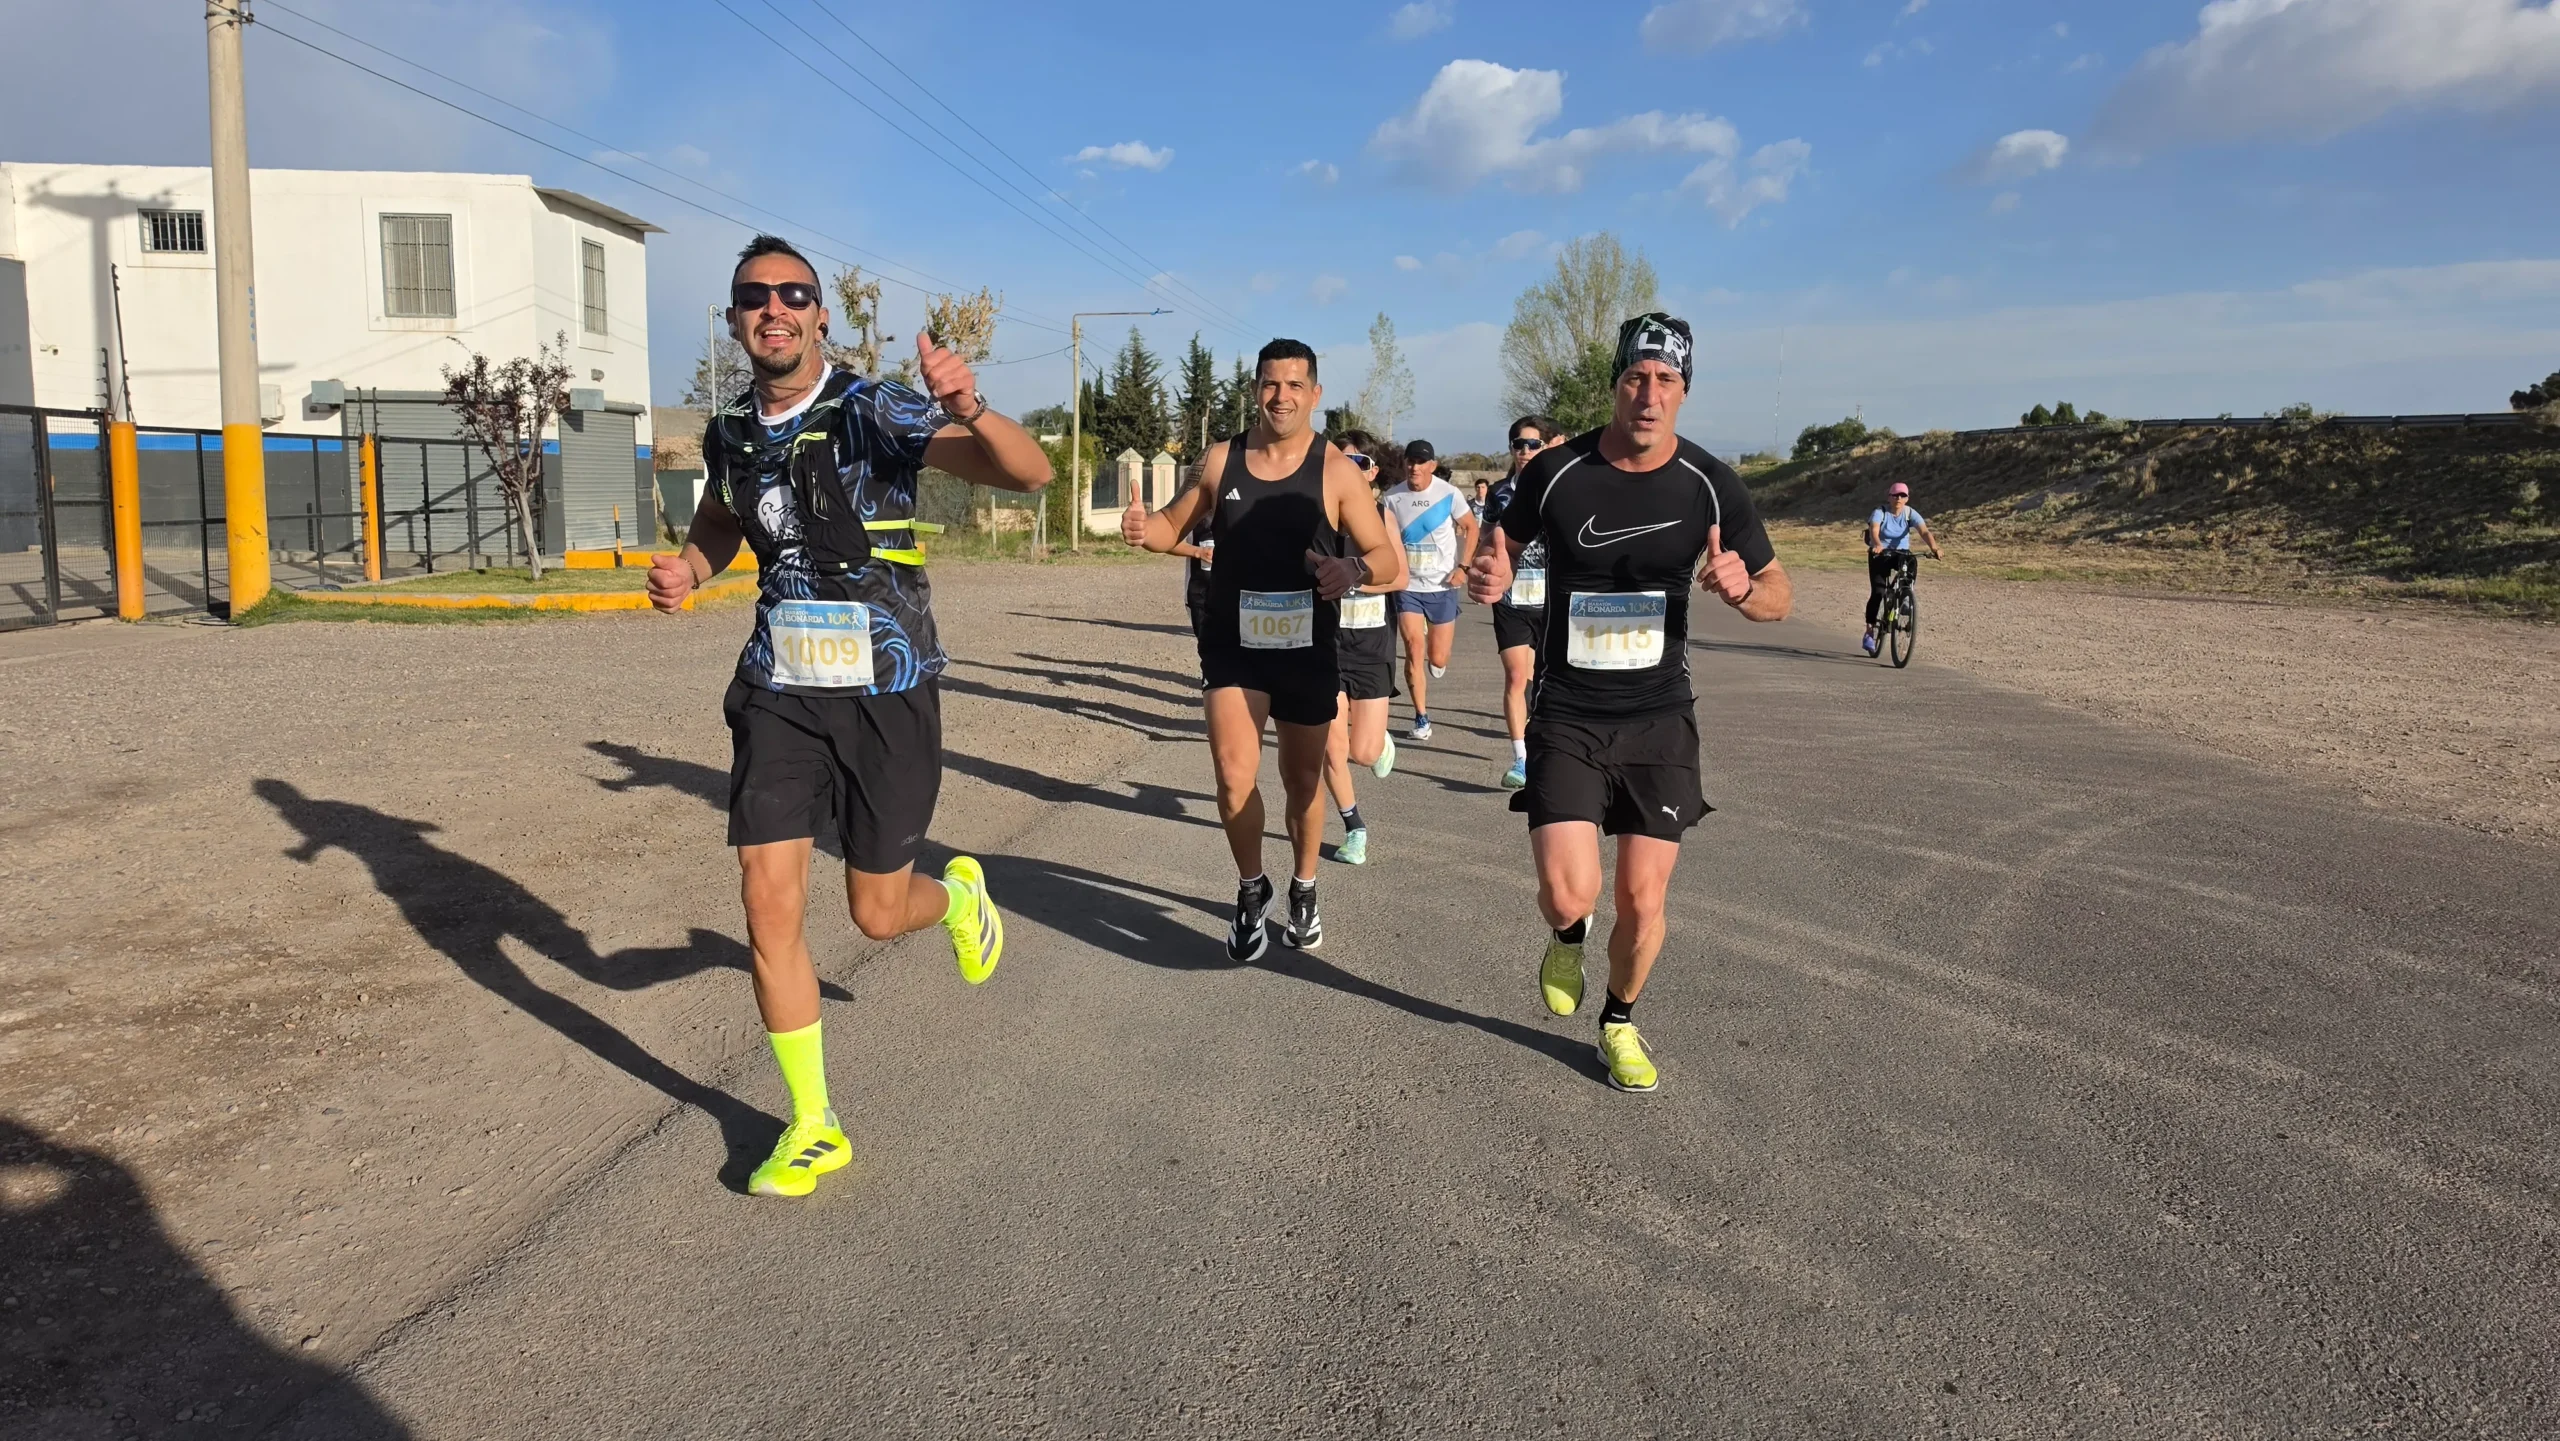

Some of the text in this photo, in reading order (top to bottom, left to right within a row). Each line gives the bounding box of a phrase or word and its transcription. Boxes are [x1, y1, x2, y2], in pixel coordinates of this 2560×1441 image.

[1411, 500, 1430, 508] ARG
[1342, 602, 1380, 618] 1078
[1628, 601, 1652, 613] 10K
[784, 612, 852, 625] BONARDA 10K
[1249, 614, 1305, 636] 1067
[1584, 624, 1652, 650] 1115
[782, 635, 860, 666] 1009
